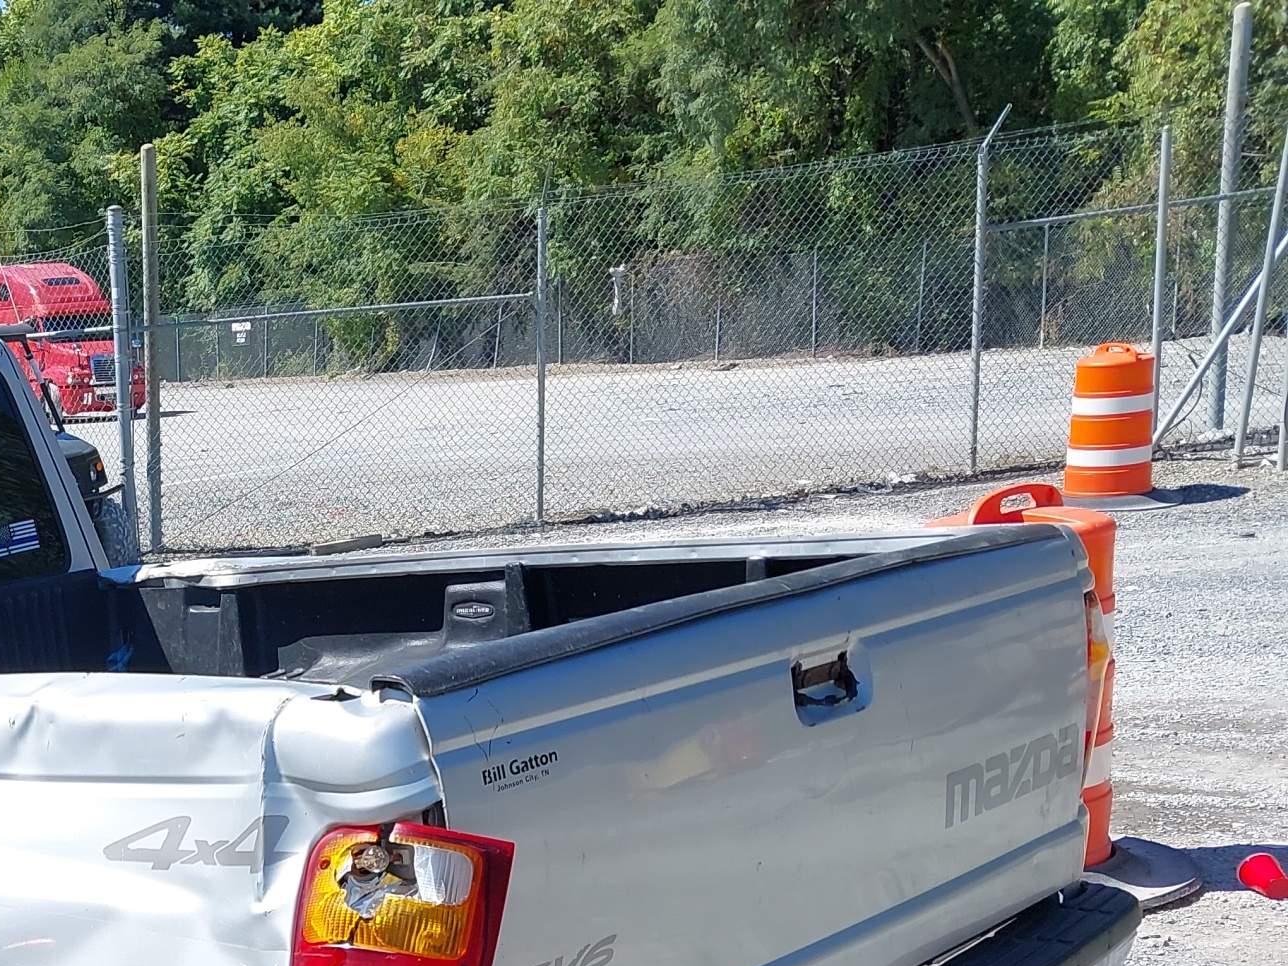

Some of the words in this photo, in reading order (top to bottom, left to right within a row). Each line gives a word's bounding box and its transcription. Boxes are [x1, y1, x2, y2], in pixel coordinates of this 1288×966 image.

[481, 764, 507, 786] Bill
[509, 751, 558, 775] Gatton
[497, 778, 524, 793] Johnson
[541, 768, 550, 778] TN
[102, 815, 300, 874] 4x4
